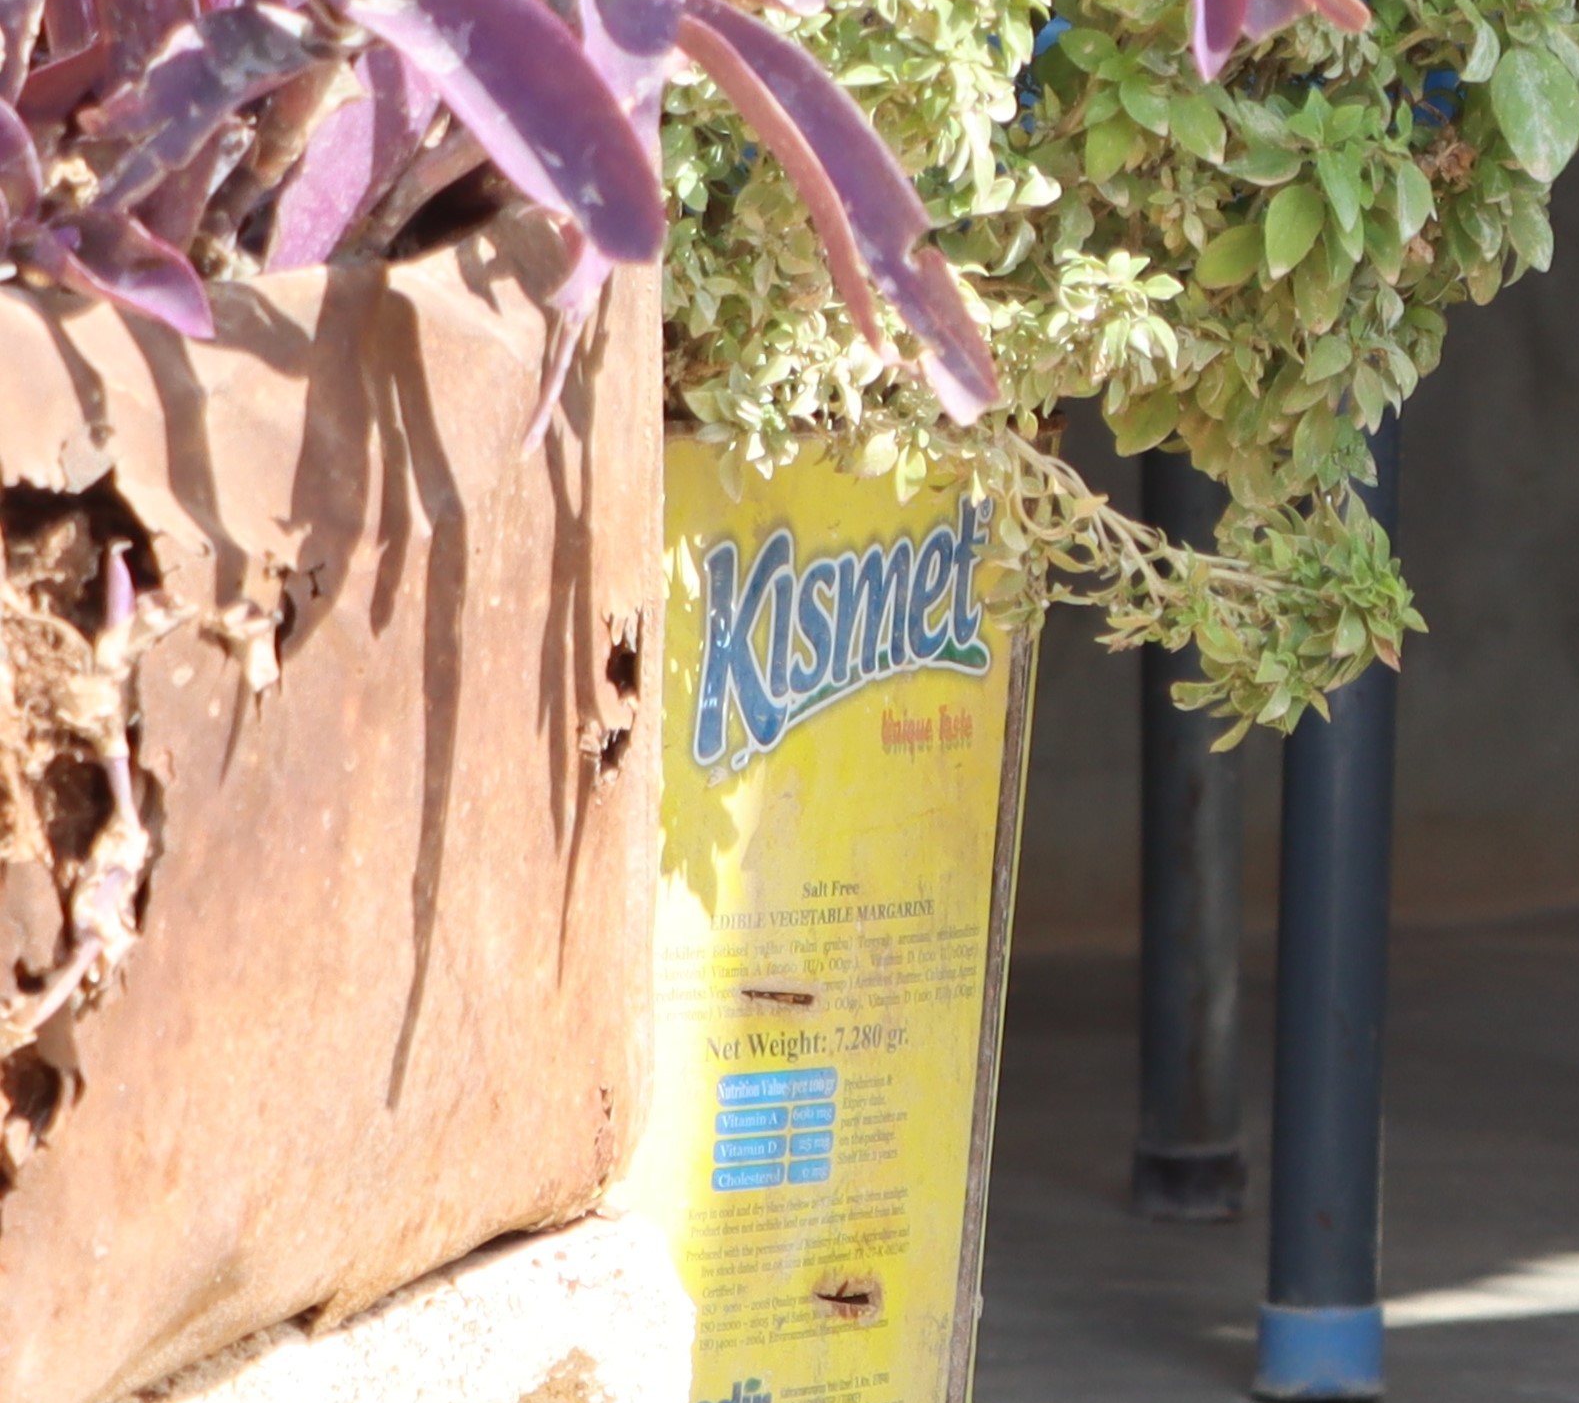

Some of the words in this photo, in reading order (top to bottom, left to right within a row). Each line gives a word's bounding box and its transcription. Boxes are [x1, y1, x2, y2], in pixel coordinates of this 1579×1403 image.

[881, 708, 932, 757] Unique
[938, 704, 973, 753] Taste
[803, 881, 827, 898] Salt
[832, 881, 859, 897] Free
[710, 912, 764, 930] EDIBLE
[770, 905, 852, 928] VEGETABLE
[857, 899, 934, 922] MARGARINE
[705, 1035, 741, 1062] Net
[747, 1030, 828, 1062] Weight:
[835, 1023, 882, 1053] 7.280
[887, 1025, 910, 1051] gr.
[718, 1079, 760, 1101] Nutrition
[723, 1111, 766, 1129] Vitamin
[768, 1111, 778, 1126] A
[815, 1106, 832, 1122] mg
[720, 1139, 764, 1158] Vitamin
[768, 1139, 777, 1154] D
[813, 1136, 831, 1152] mg
[718, 1168, 781, 1188] Cholesterol
[811, 1163, 828, 1180] mg
[691, 1224, 720, 1238] Product
[722, 1222, 738, 1234] does
[686, 1246, 721, 1261] Produced
[724, 1244, 739, 1257] with
[742, 1243, 752, 1255] the
[701, 1304, 715, 1315] ISO
[700, 1322, 715, 1334] ISO
[699, 1339, 714, 1351] ISO
